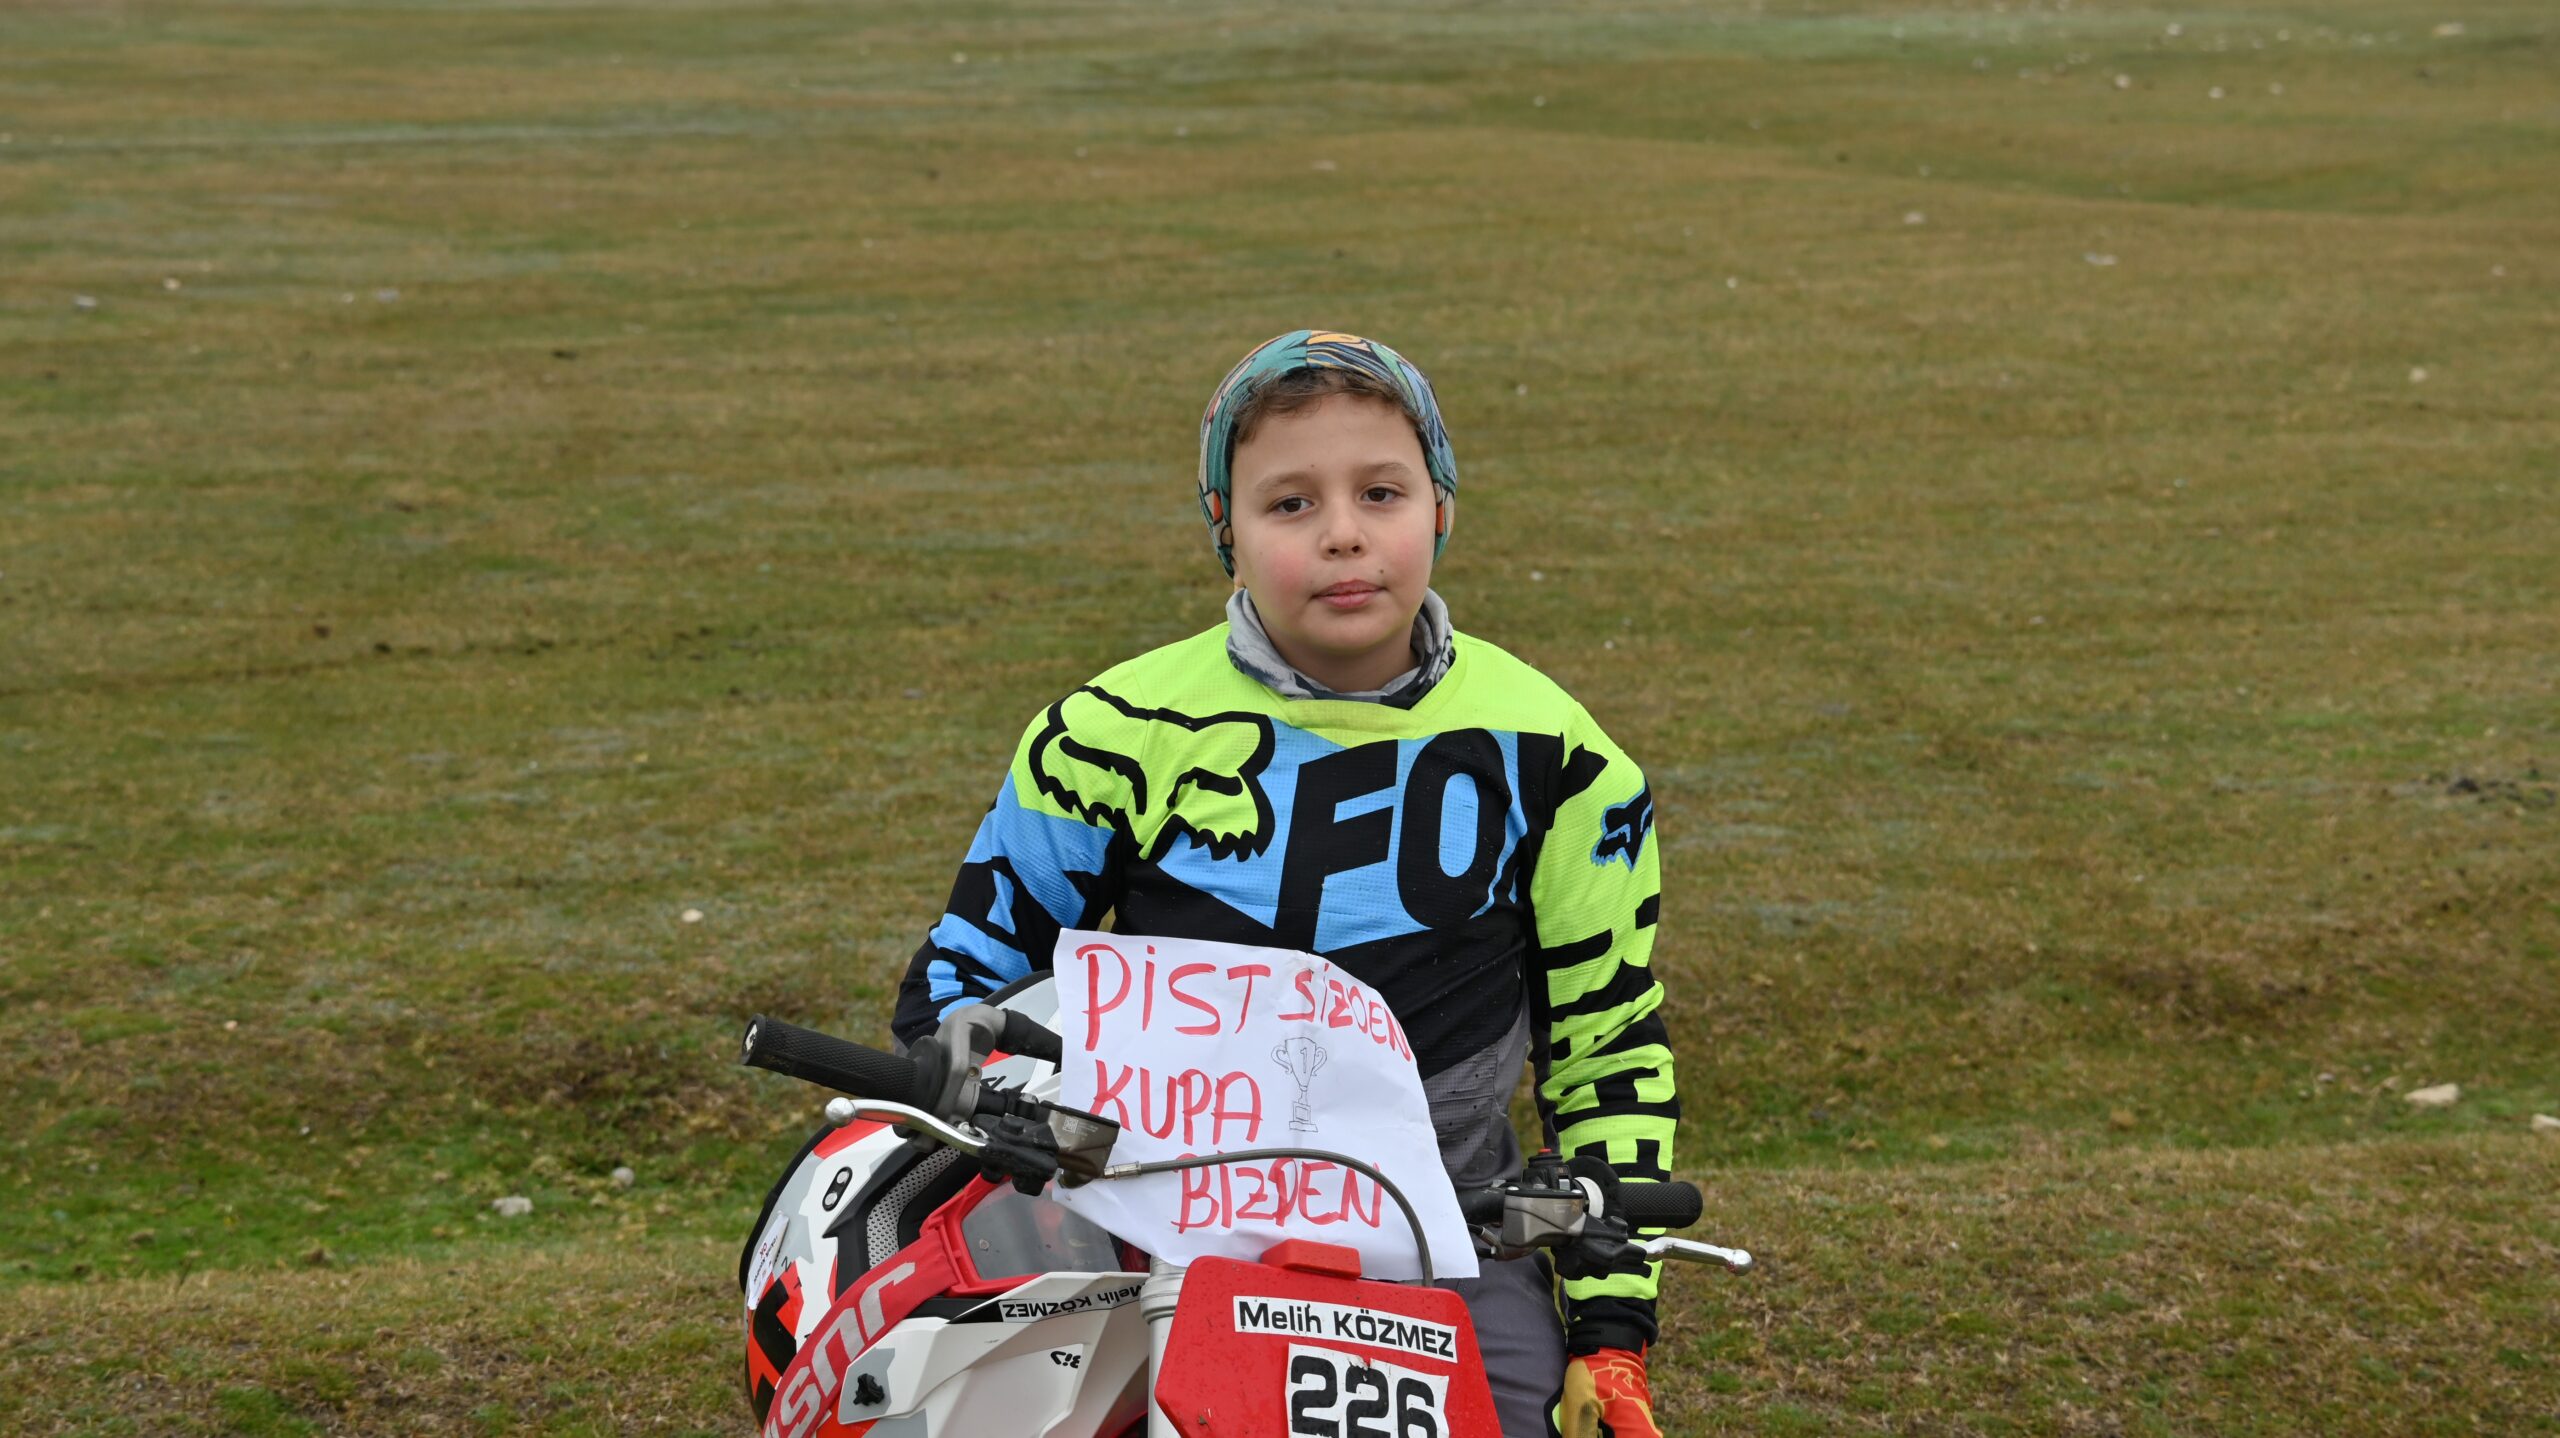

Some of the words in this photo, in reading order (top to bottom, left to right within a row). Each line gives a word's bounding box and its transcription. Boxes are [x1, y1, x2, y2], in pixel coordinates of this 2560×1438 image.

[1087, 1059, 1264, 1146] KUPA
[1002, 1295, 1093, 1318] KÖZMEZ
[1238, 1300, 1323, 1334] Melih
[1332, 1308, 1455, 1358] KÖZMEZ
[764, 1261, 916, 1438] JUS
[1290, 1354, 1438, 1438] 226
